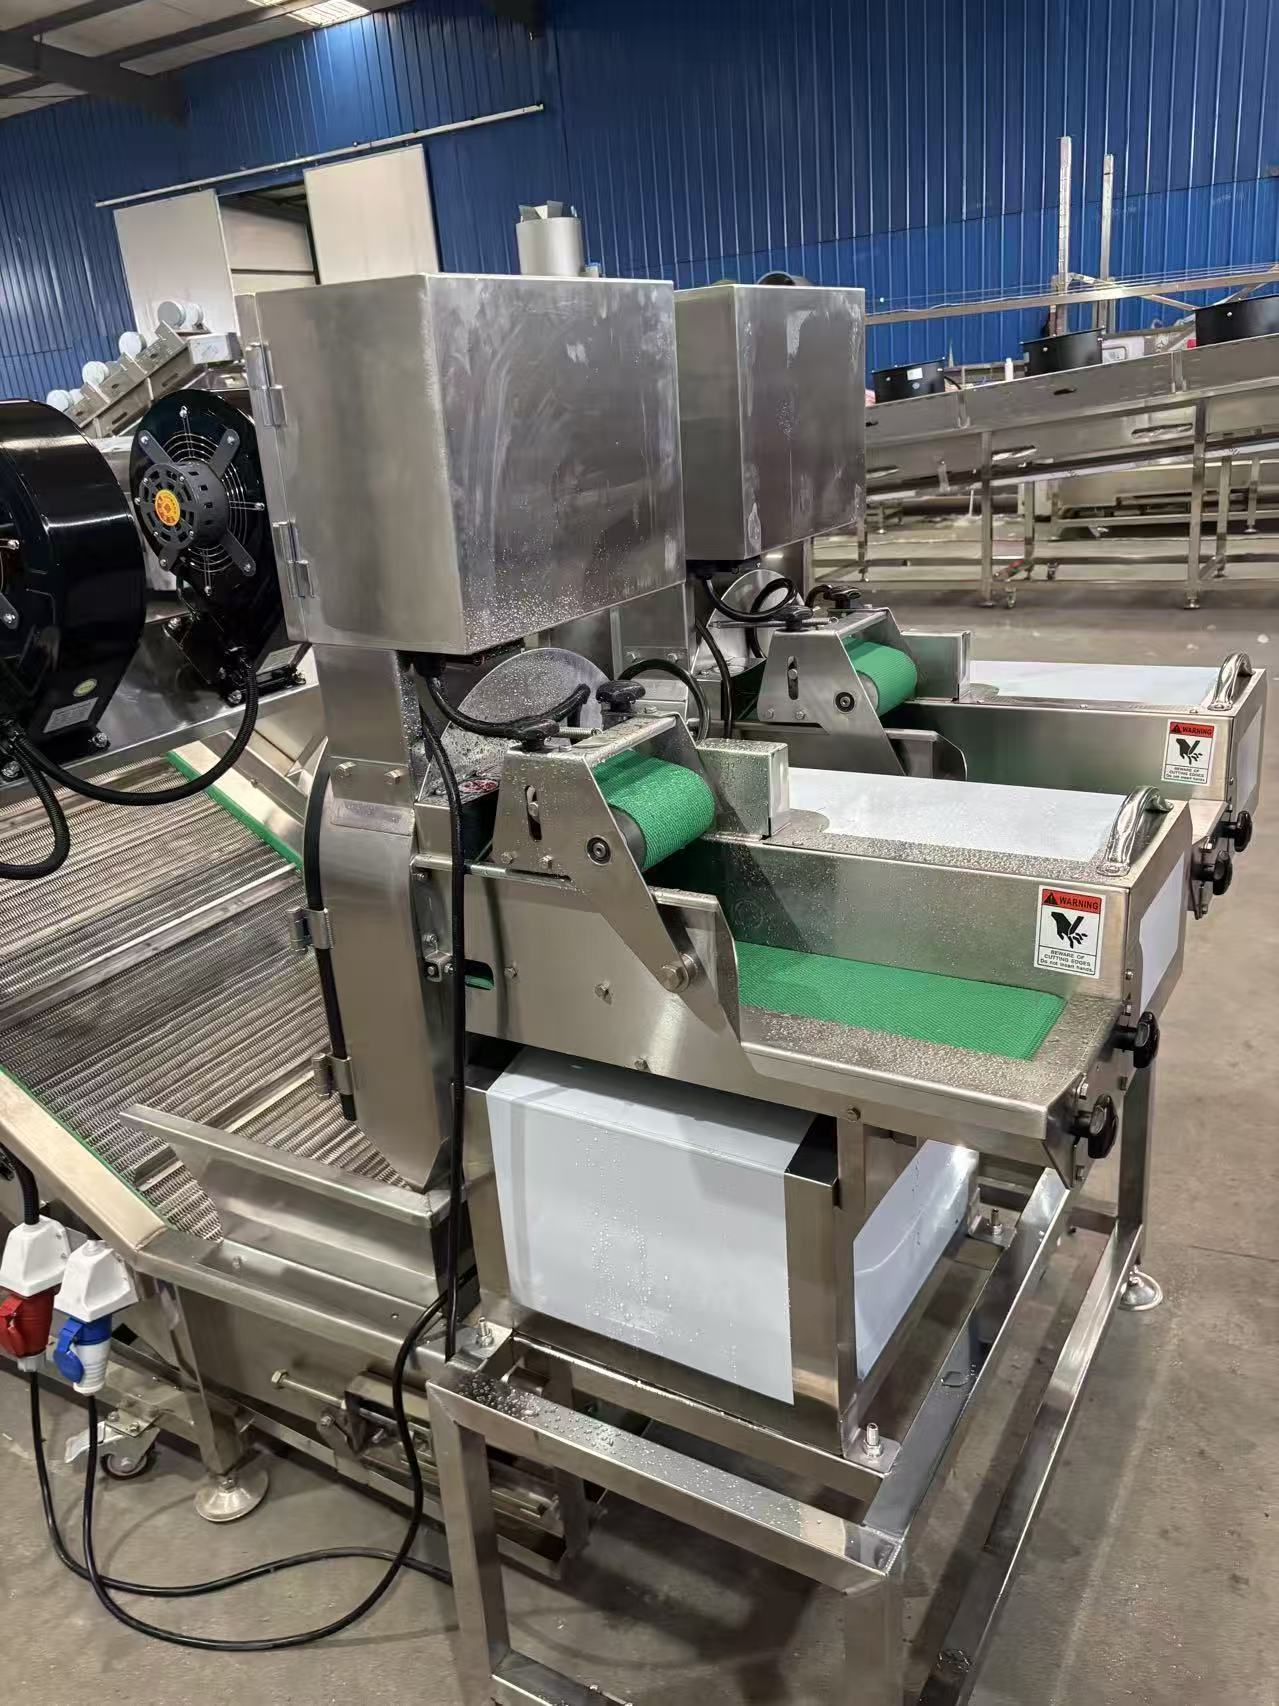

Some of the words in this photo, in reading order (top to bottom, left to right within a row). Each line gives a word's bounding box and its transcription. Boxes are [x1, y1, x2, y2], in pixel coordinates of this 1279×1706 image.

[1182, 726, 1212, 735] WARNING
[1059, 897, 1099, 910] WARNING
[1050, 949, 1075, 958] BEWARE
[1043, 953, 1069, 963] CUTTING
[1071, 958, 1091, 967] EDGES
